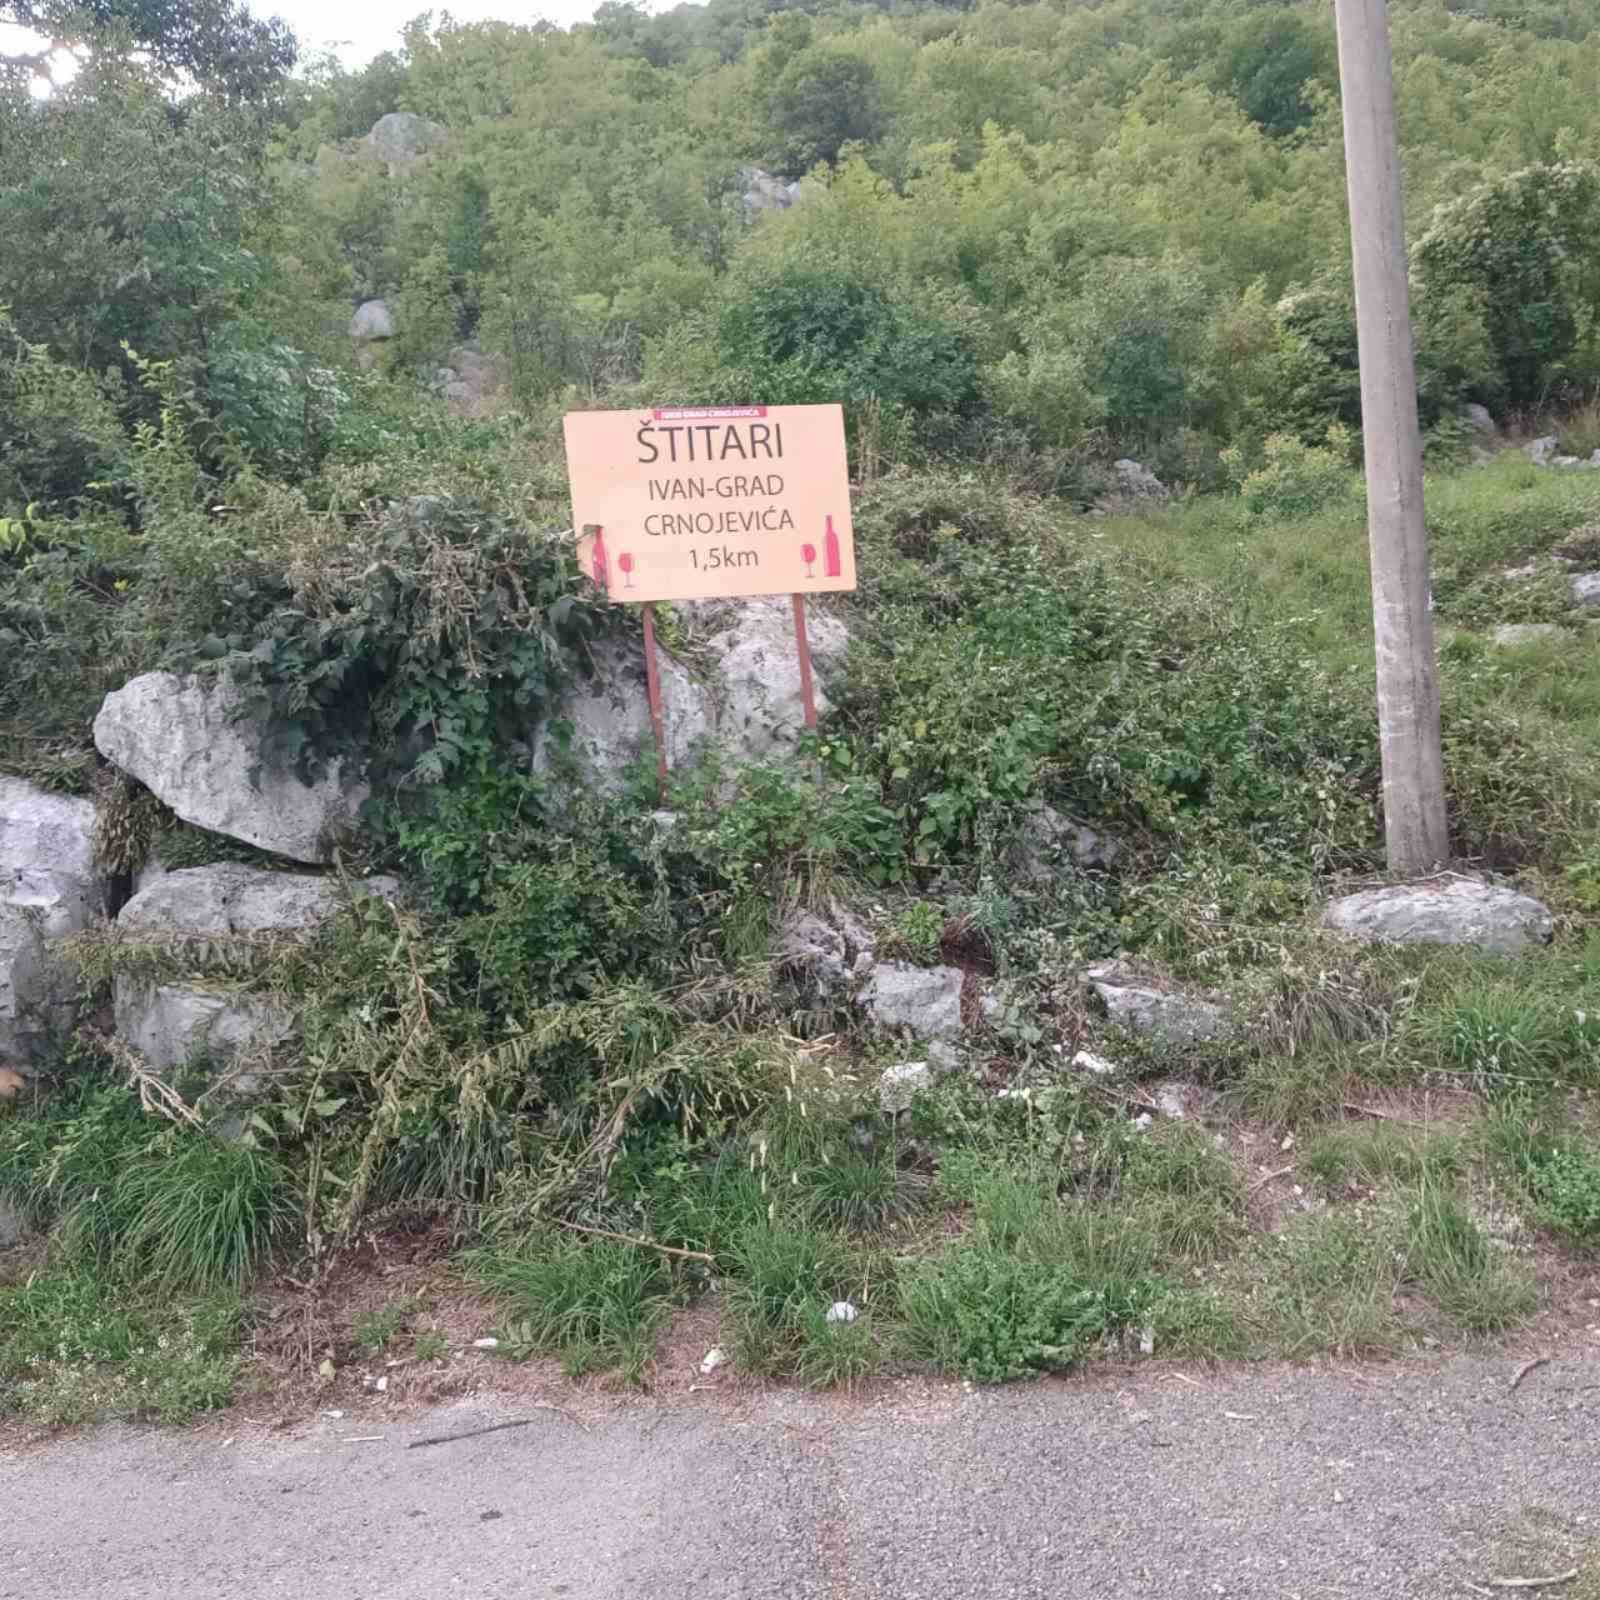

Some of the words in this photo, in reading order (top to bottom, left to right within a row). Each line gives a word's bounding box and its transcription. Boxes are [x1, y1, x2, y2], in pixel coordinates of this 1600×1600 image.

[637, 420, 783, 463] ŠTITARI
[649, 475, 784, 500] IVAN-GRAD
[644, 505, 794, 536] CRNOJEVIĆA
[689, 546, 758, 571] 1,5km
